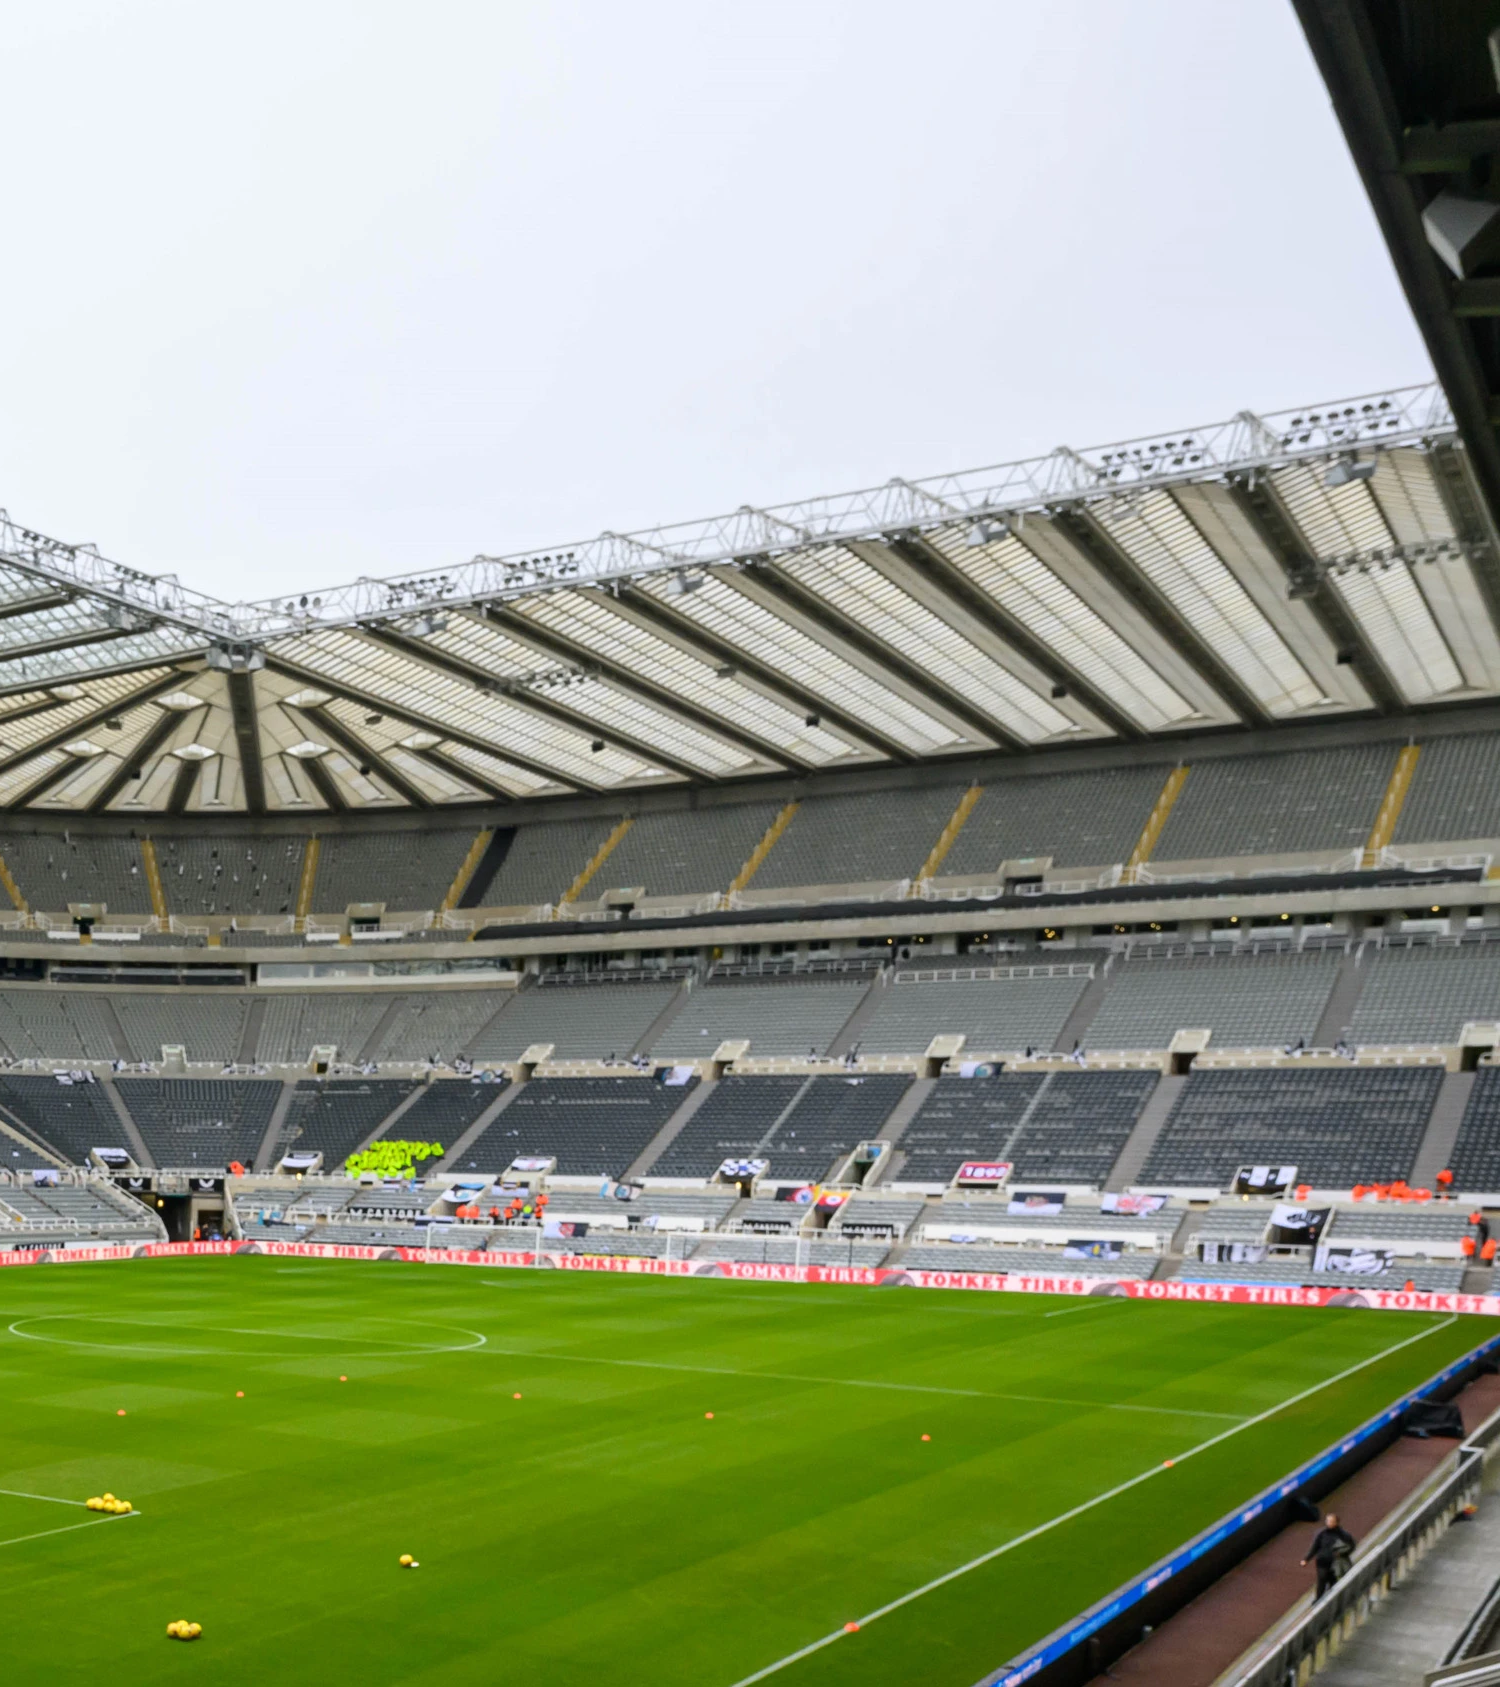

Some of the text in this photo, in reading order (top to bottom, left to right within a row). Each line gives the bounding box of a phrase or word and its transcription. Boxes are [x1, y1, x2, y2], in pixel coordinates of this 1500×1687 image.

[56, 1246, 131, 1262] TOMKET TIRES
[151, 1241, 232, 1256] TOMKET TIRES
[266, 1242, 375, 1258] TOMKET TIRES
[407, 1248, 525, 1265] TOMKET TIRES
[1, 1250, 35, 1265] TIRES
[560, 1256, 689, 1274] TOMKET TIRES
[729, 1264, 876, 1283] TOMKET TIRES
[920, 1271, 1085, 1294] TOMKET TIRES
[1134, 1282, 1321, 1305] TOMKET TIRES
[1377, 1292, 1486, 1313] TOMKET
